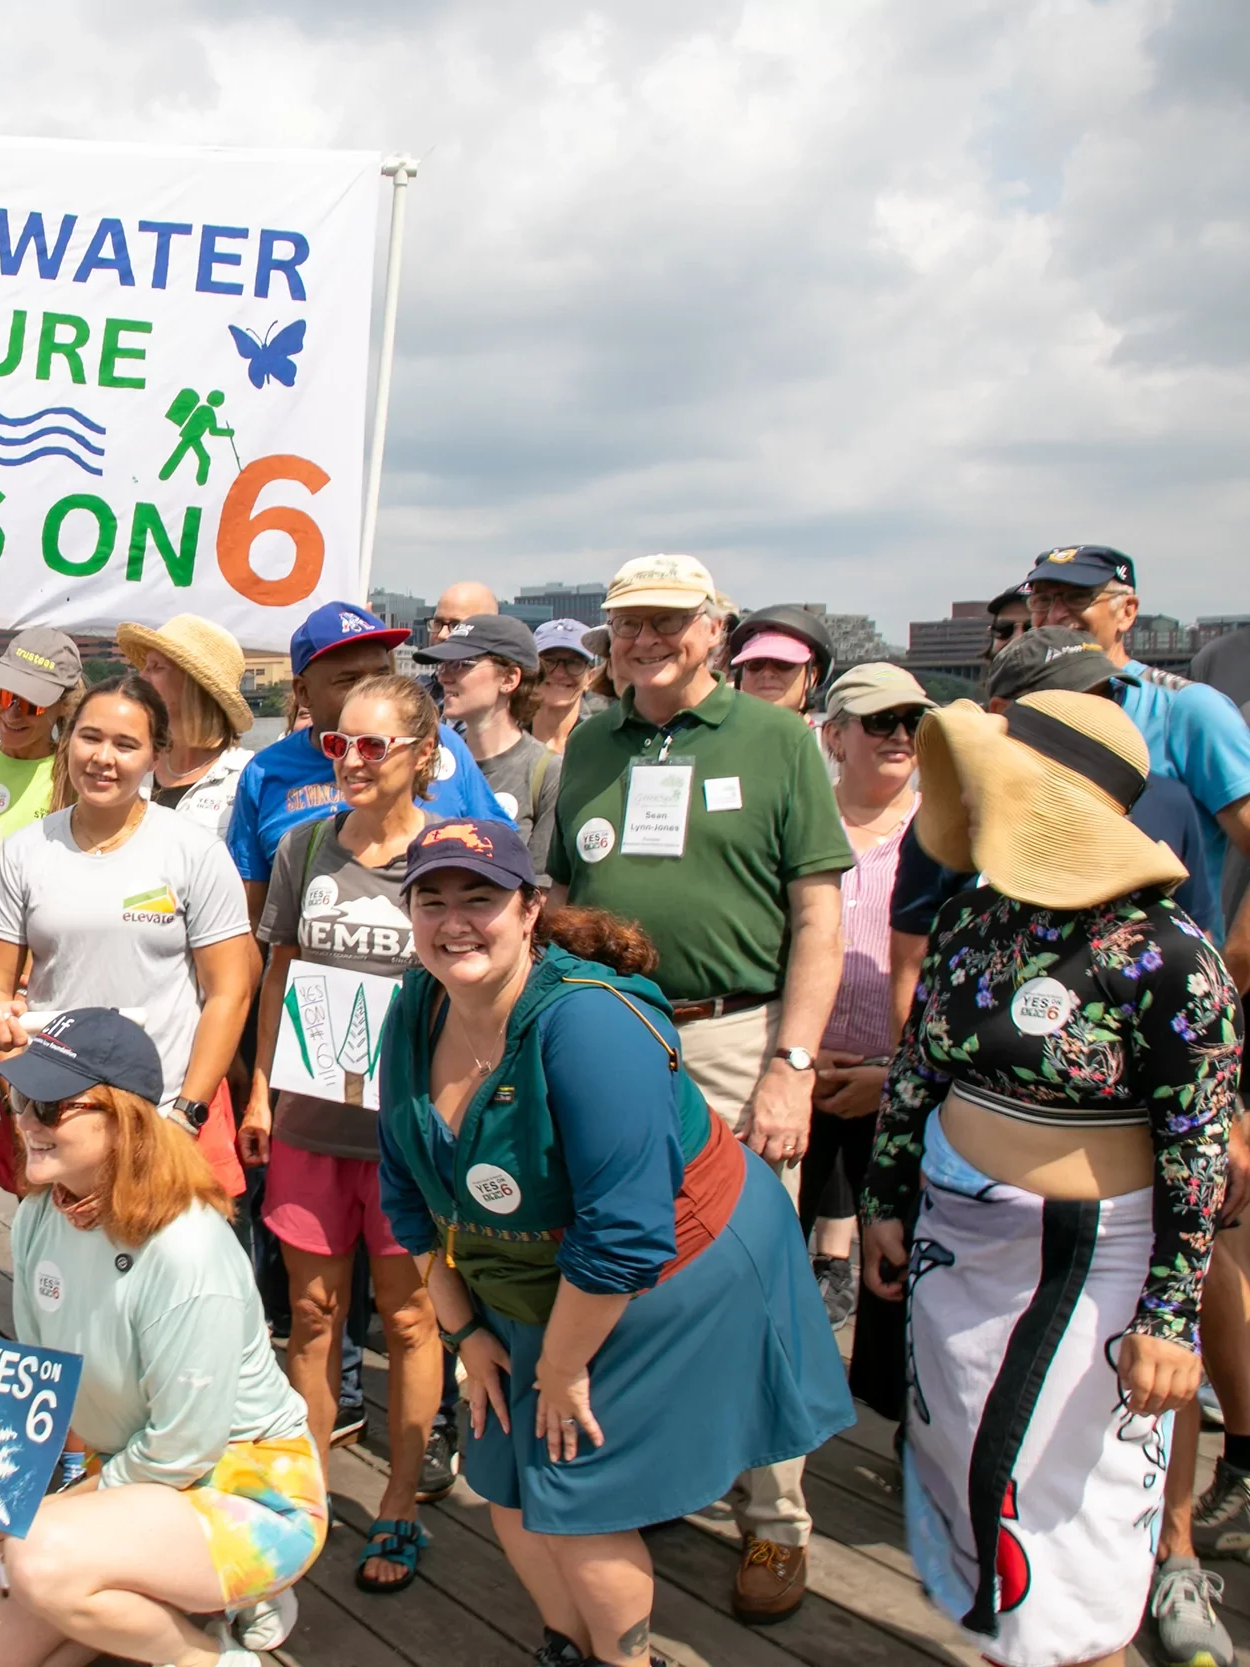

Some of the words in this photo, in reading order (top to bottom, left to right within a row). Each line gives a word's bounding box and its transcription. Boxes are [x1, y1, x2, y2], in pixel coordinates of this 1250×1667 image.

[42, 493, 203, 588] ON
[215, 454, 332, 607] 6
[16, 648, 56, 670] trustees
[645, 811, 668, 820] Sean
[630, 823, 680, 832] Lynn-Jones
[584, 833, 601, 843] YES
[600, 837, 609, 848] 6
[309, 890, 324, 898] YES
[322, 895, 330, 905] 6
[299, 984, 324, 1003] YES
[1022, 996, 1050, 1009] YES
[1051, 998, 1062, 1006] ON
[304, 1005, 326, 1026] ON
[1047, 1006, 1060, 1020] 6
[310, 1028, 325, 1041] #
[316, 1042, 334, 1069] 6
[474, 1180, 500, 1194] YES
[499, 1183, 514, 1197] 6
[52, 1286, 60, 1300] 6
[39, 1360, 63, 1383] ON
[25, 1389, 58, 1443] 6
